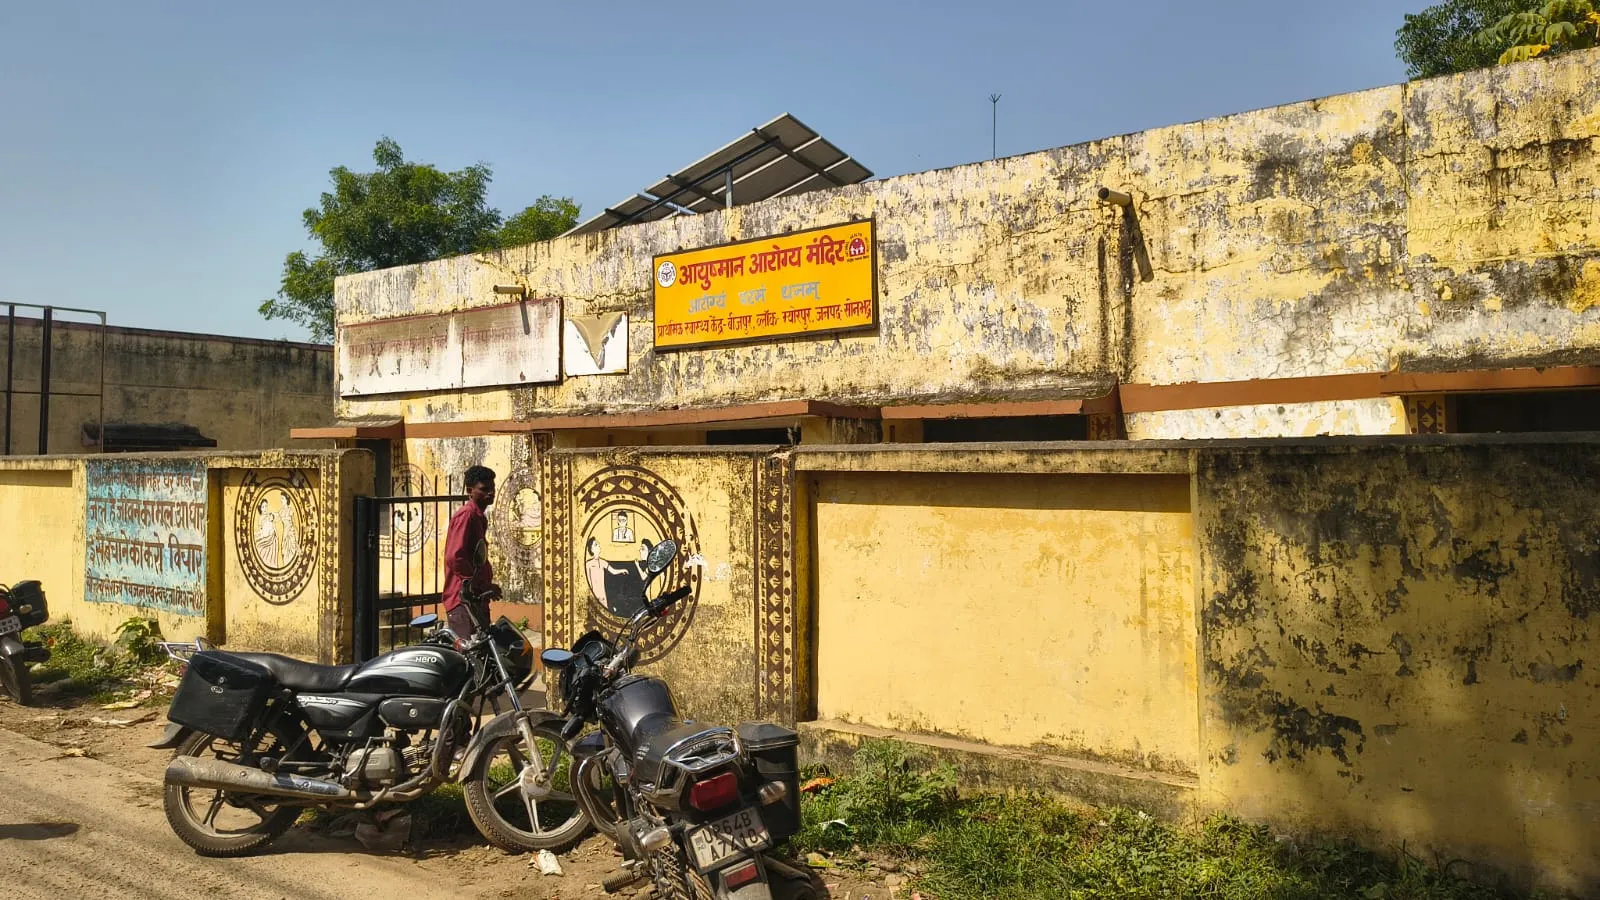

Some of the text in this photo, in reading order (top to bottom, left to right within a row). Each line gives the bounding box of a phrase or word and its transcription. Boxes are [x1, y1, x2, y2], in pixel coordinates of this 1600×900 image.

[679, 255, 747, 291] आयुष्मान
[749, 245, 803, 275] आरोग्य
[806, 234, 846, 267] मंदिर
